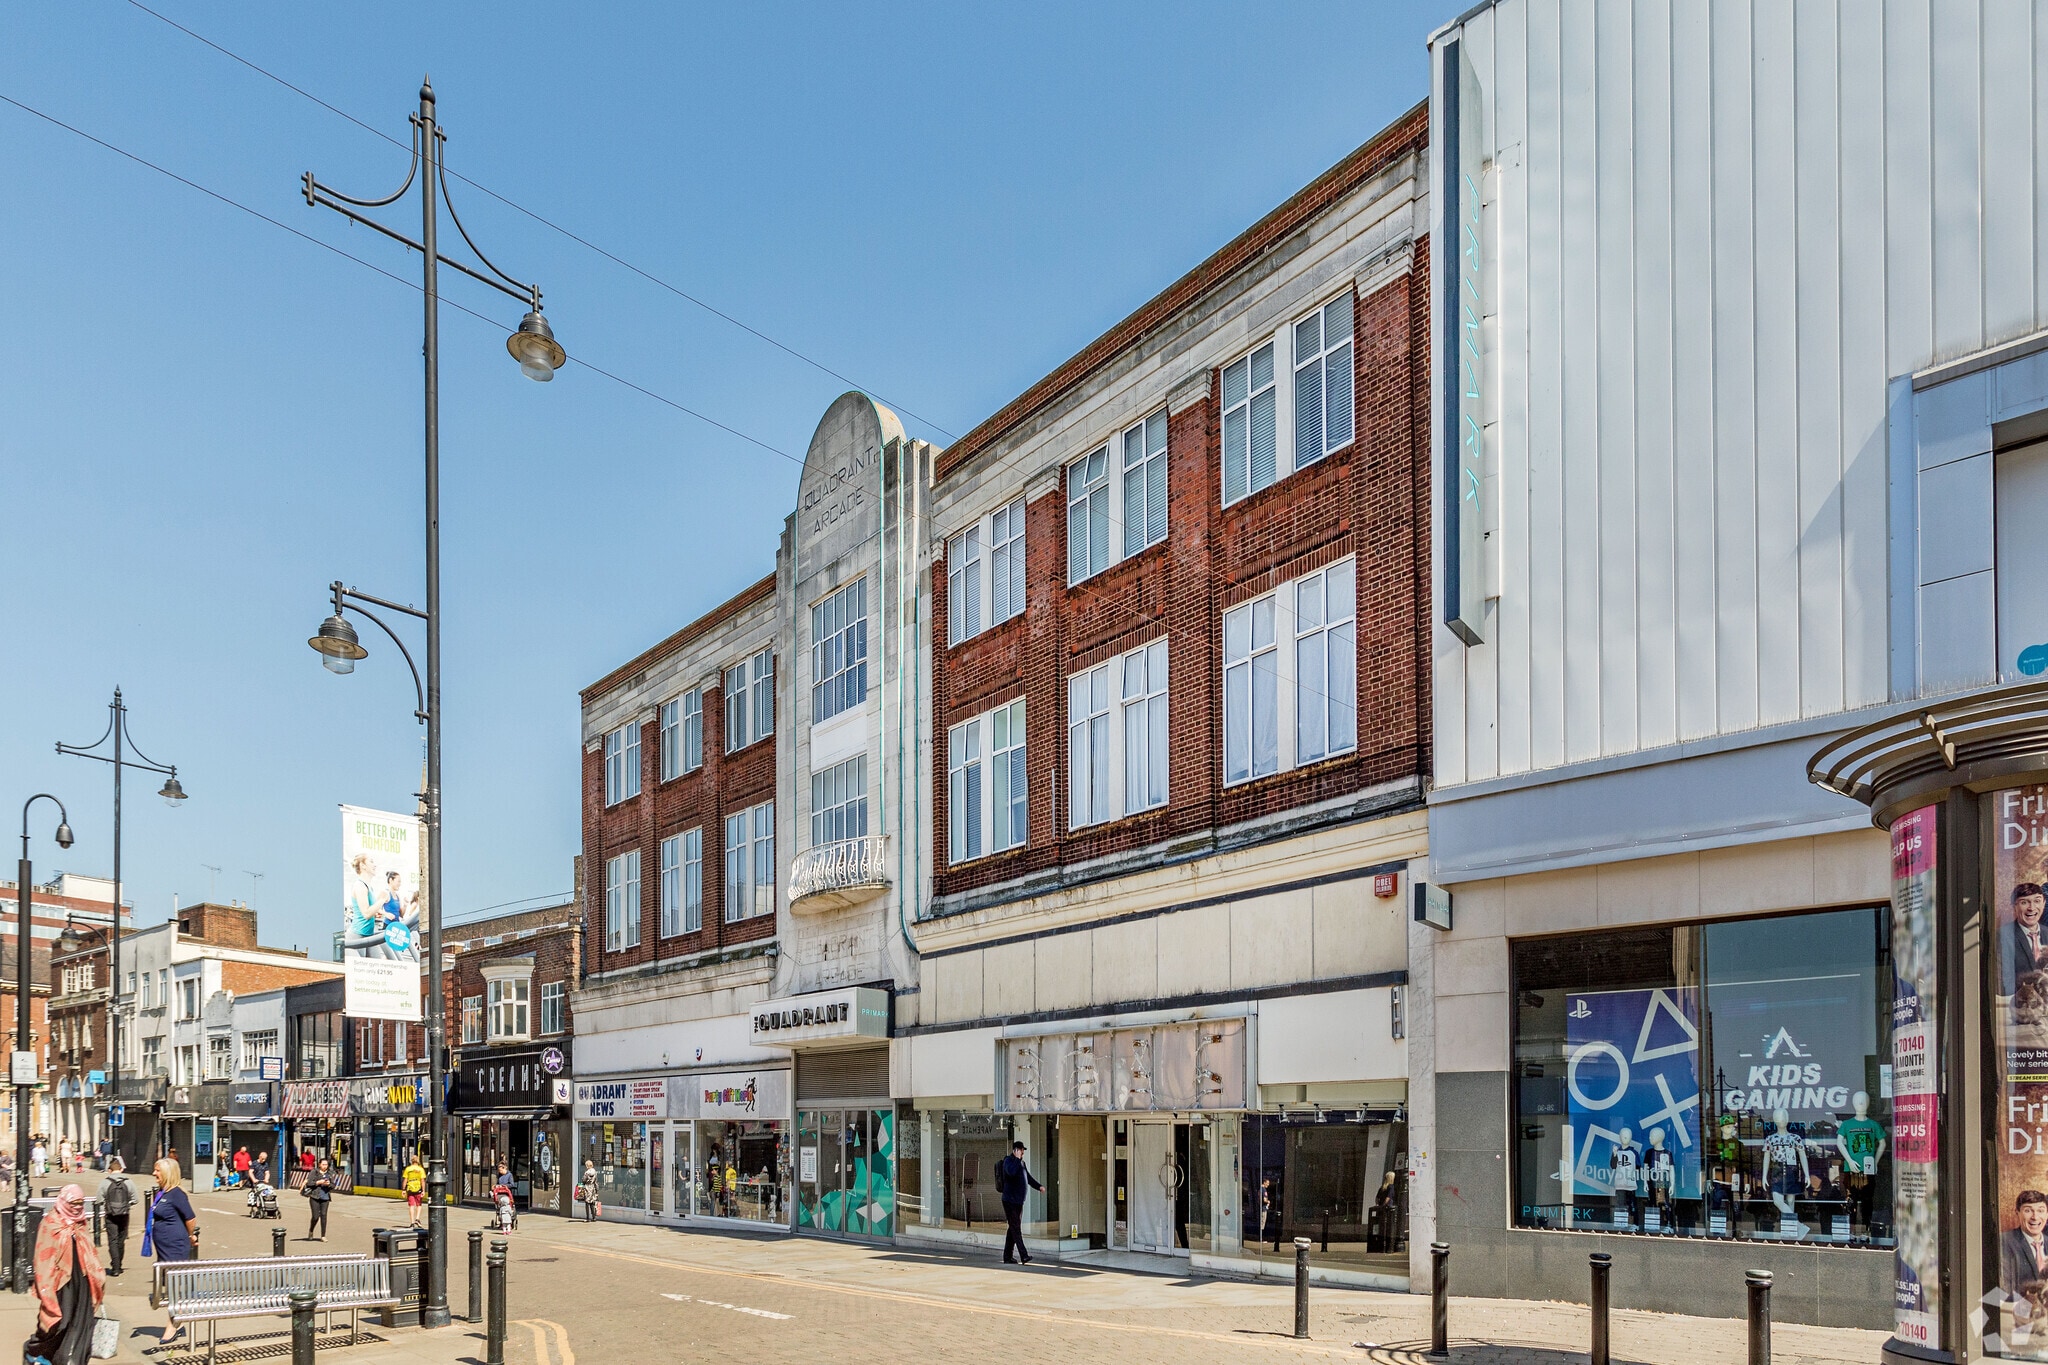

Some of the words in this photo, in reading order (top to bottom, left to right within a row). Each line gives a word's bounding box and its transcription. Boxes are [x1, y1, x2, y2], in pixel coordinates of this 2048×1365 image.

[1465, 172, 1480, 513] PRIMARK
[804, 446, 874, 511] QUADRANT
[814, 485, 865, 535] ARCADE
[2003, 786, 2048, 818] Fri
[356, 821, 388, 838] BETTER
[389, 826, 407, 841] GYM
[1906, 835, 1922, 851] US
[759, 1002, 849, 1031] QUADRANT
[1899, 1053, 1925, 1068] MONTH
[2007, 1049, 2035, 1060] Lovely
[2006, 1060, 2026, 1068] New
[1747, 1063, 1822, 1087] KIDS
[306, 1086, 344, 1104] BARBERS
[578, 1084, 627, 1101] QUADRANT
[1724, 1085, 1850, 1111] GAMING
[590, 1101, 615, 1117] NEWS
[1902, 1103, 1926, 1112] MISSING
[1754, 1119, 1816, 1131] PRIARK
[1910, 1123, 1926, 1137] US
[1901, 1321, 1928, 1341] 70140
